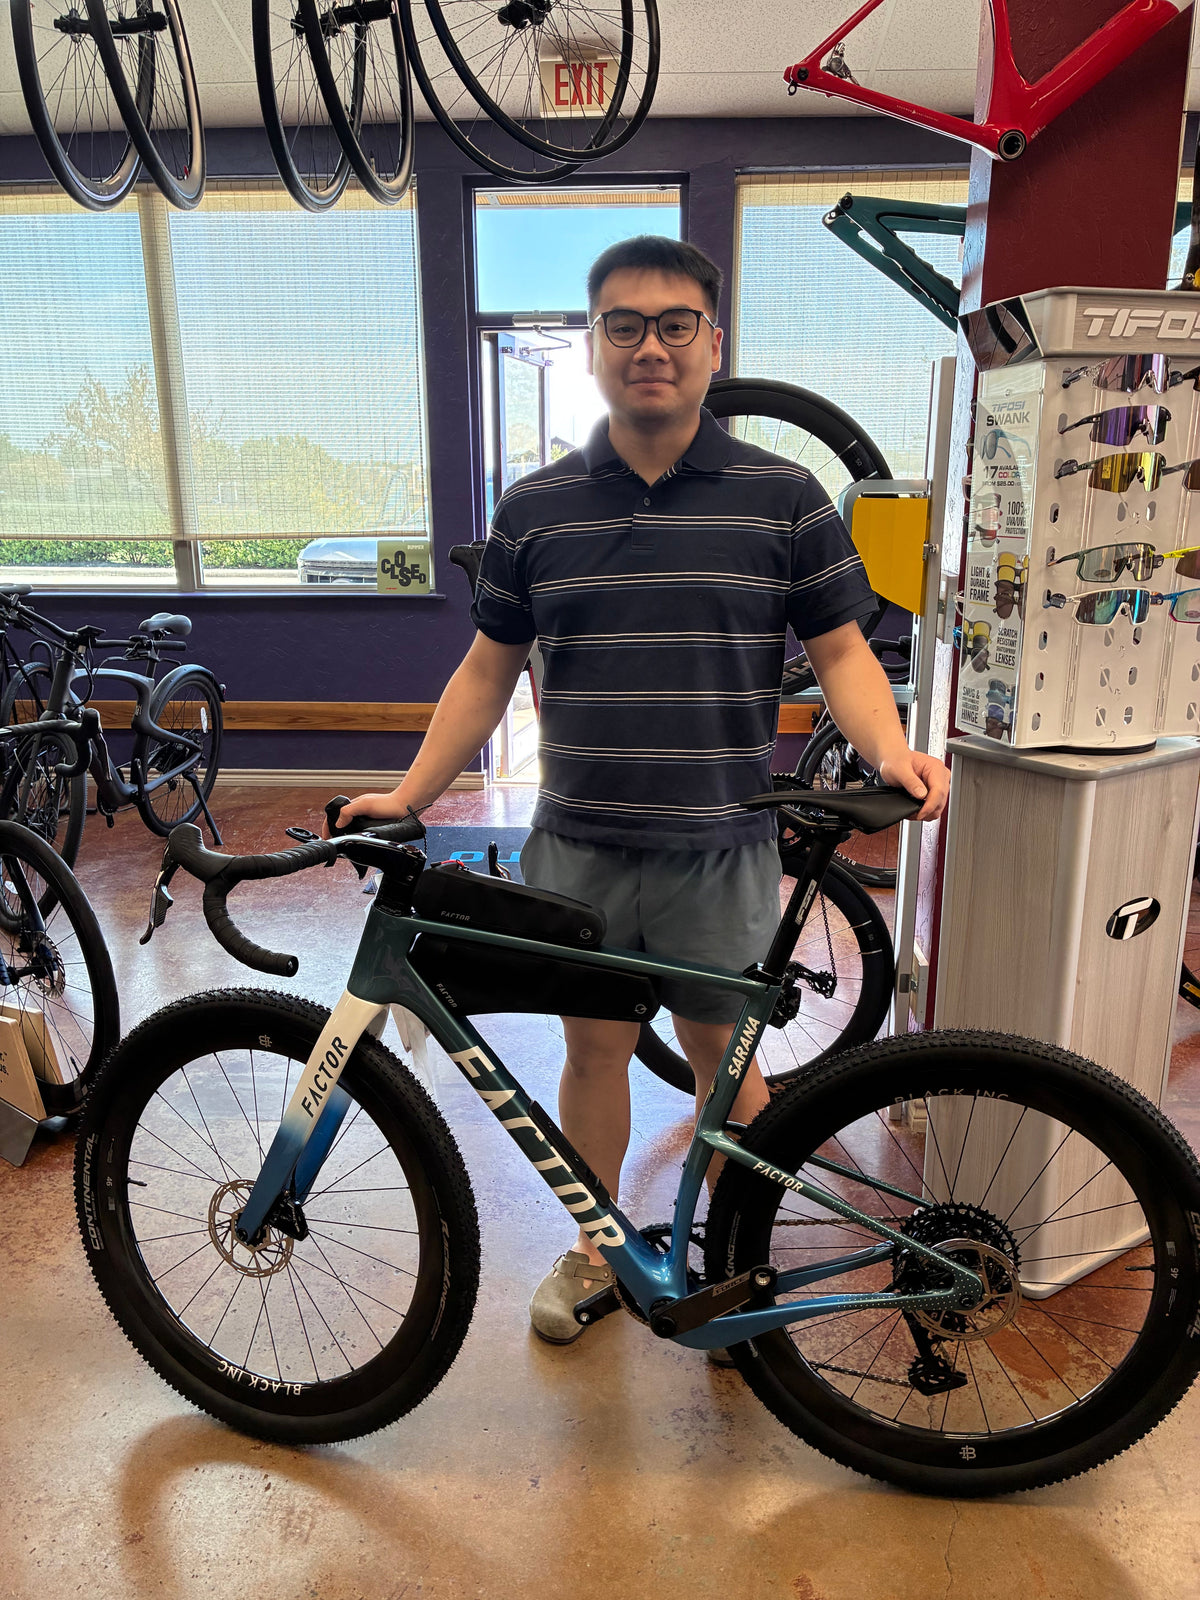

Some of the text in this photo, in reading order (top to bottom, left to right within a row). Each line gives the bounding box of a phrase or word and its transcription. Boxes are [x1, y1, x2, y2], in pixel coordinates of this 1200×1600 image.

[555, 62, 608, 105] EXIT
[992, 401, 1026, 412] TIFOSI
[986, 412, 1030, 426] SWANK
[984, 465, 998, 479] 17
[381, 551, 426, 587] CLOSED
[971, 566, 985, 577] LIGHT
[970, 577, 990, 589] DURABLE
[970, 588, 990, 602] FRAME
[995, 653, 1015, 666] LENSES
[961, 709, 978, 724] HINGE
[441, 910, 471, 921] FACTOR
[437, 983, 458, 1008] FACTOR
[728, 1016, 761, 1080] SARANA
[301, 1036, 348, 1118] FACTOR
[753, 1161, 804, 1192] FACTOR
[82, 1132, 101, 1251] CONTINENTAL
[217, 1360, 302, 1396] BLACK INC
